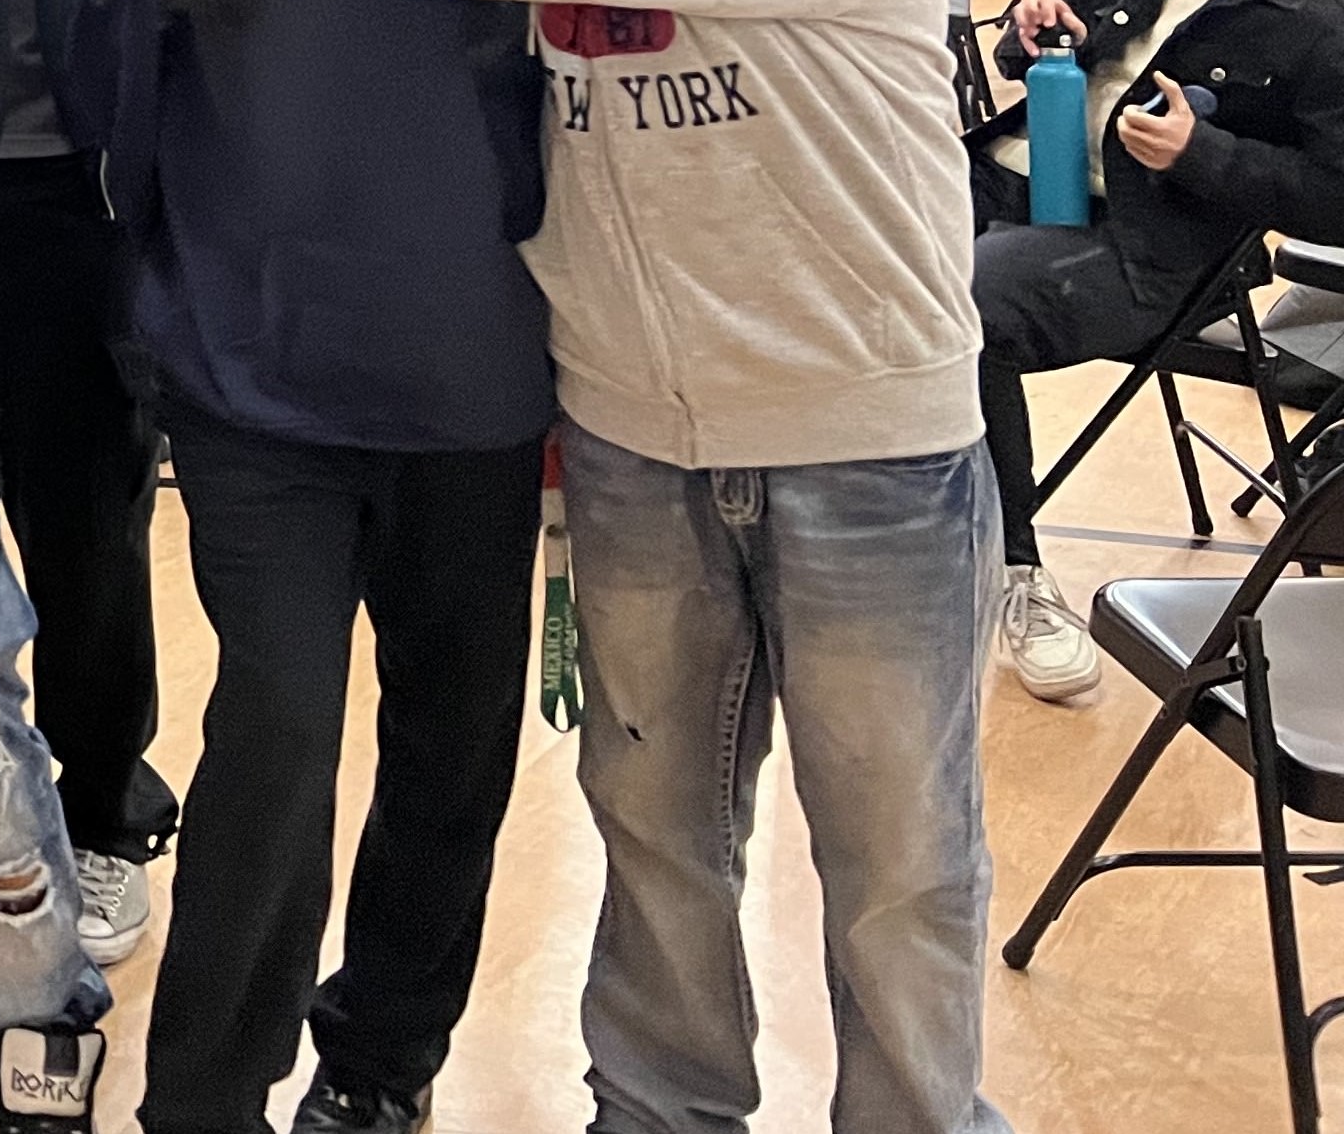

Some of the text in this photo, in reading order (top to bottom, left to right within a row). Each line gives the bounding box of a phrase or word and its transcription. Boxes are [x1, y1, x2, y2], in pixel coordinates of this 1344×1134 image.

[552, 61, 760, 133] W YORK
[542, 616, 562, 691] MEXICO
